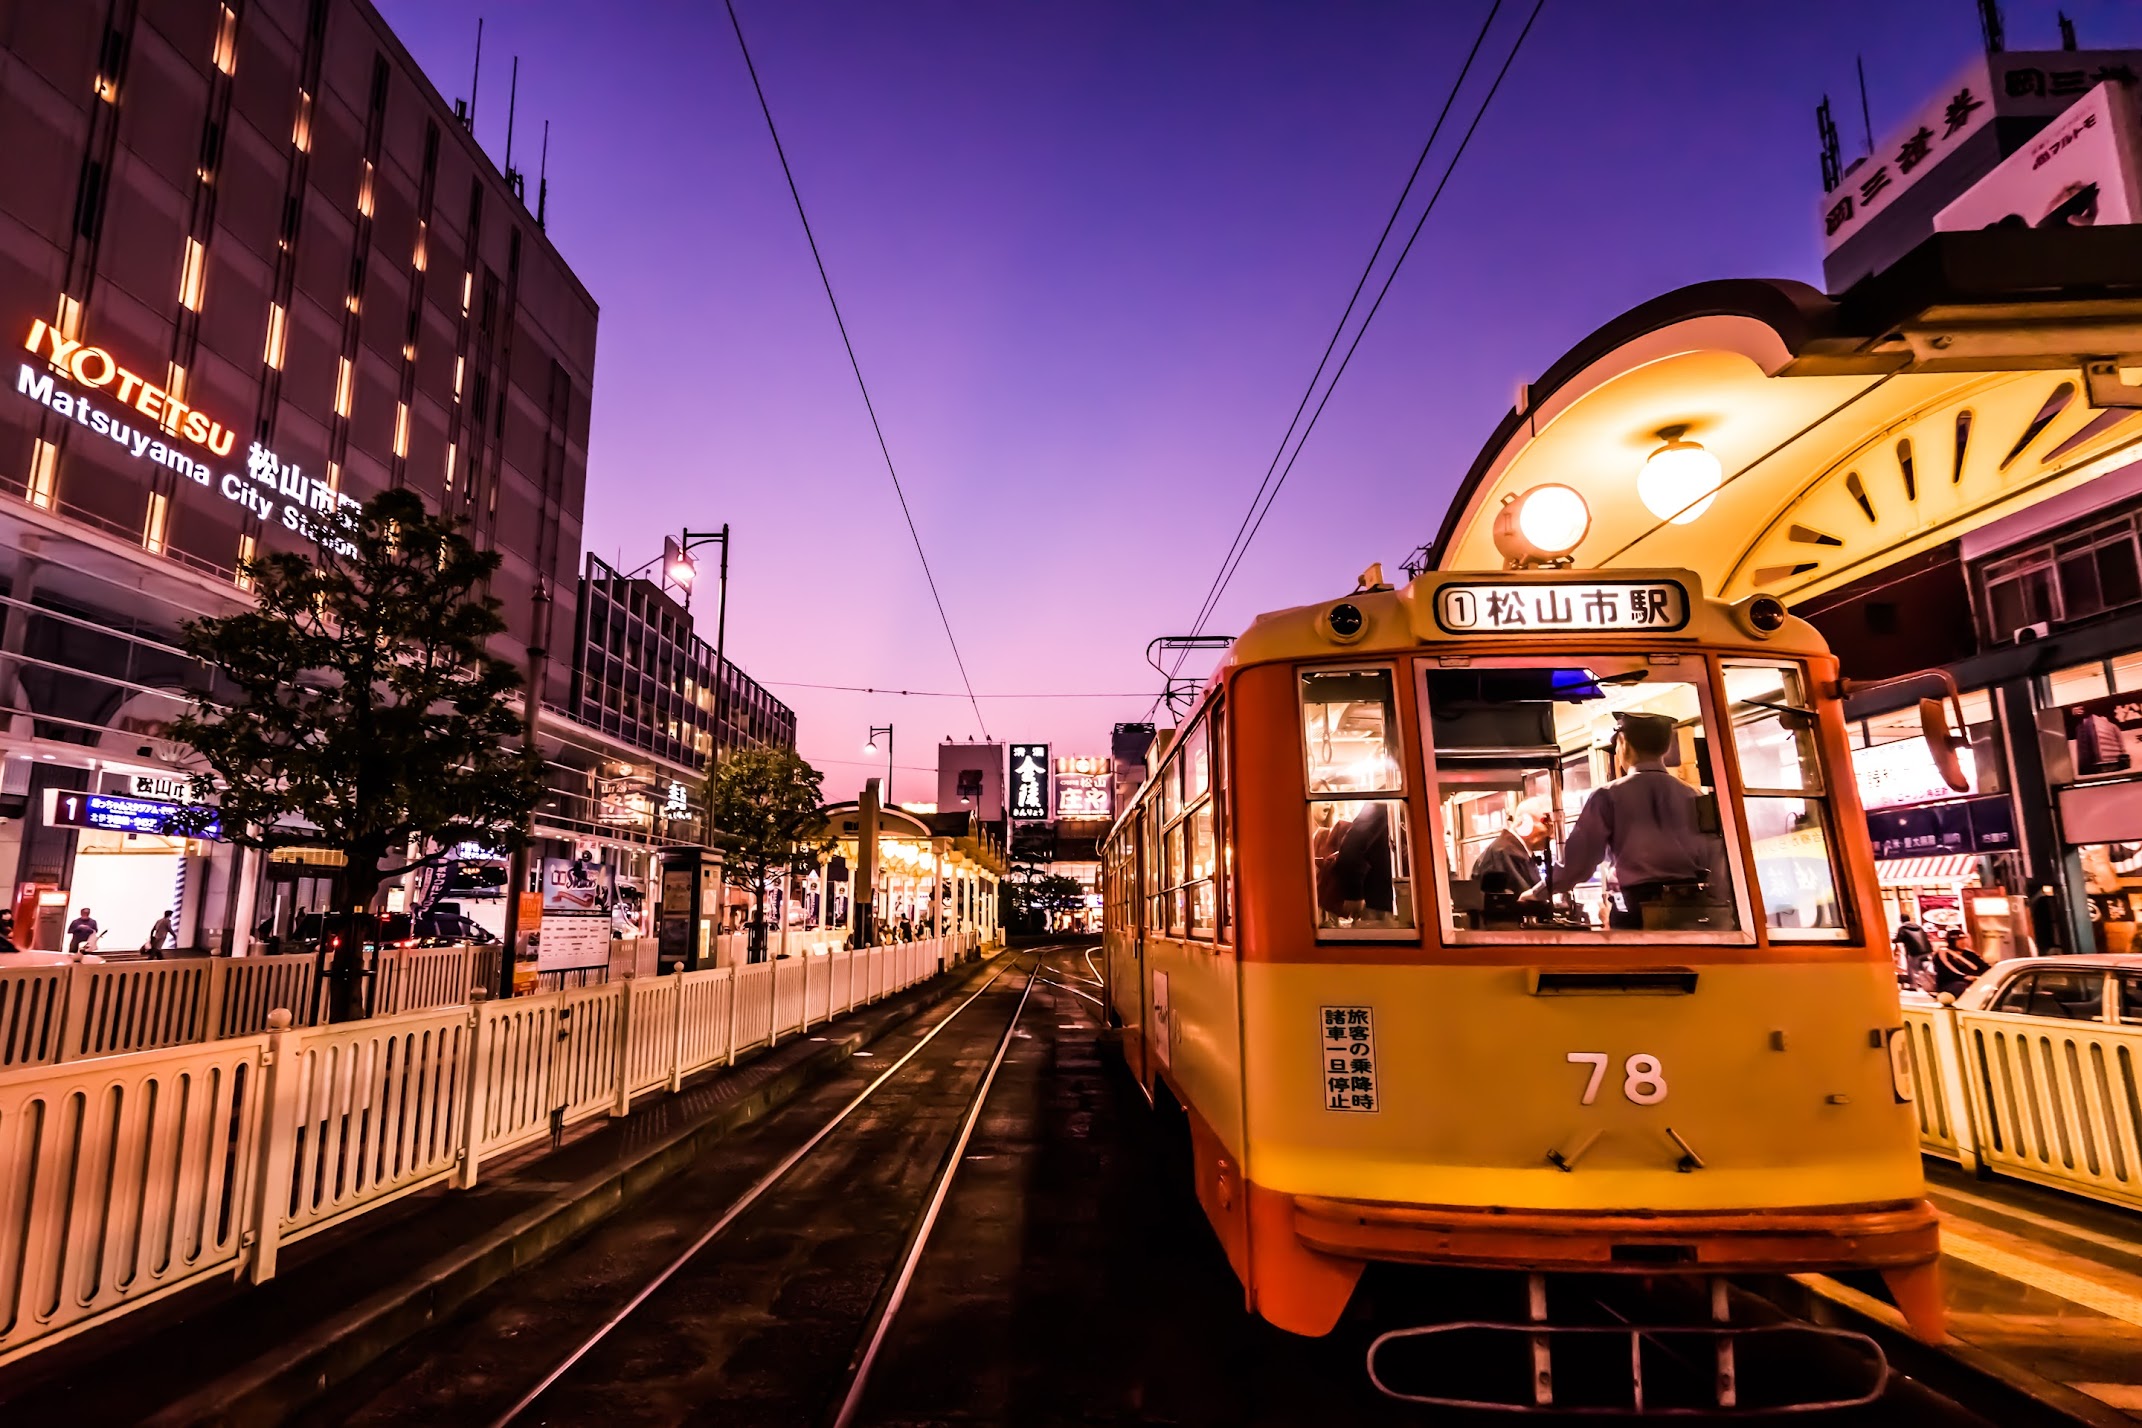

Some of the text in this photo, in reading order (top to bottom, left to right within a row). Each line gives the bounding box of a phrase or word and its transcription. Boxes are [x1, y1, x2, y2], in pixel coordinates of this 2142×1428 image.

[25, 318, 236, 457] IYOTETSU
[17, 363, 211, 487] Matsuyama
[221, 473, 274, 520] City
[1486, 588, 1670, 627] 松山市駅
[66, 797, 77, 821] 1
[1059, 787, 1108, 809] 庄や
[1080, 777, 1107, 788] 松山
[1325, 1009, 1351, 1109] 諸車一旦停止
[1347, 1009, 1374, 1110] 旅客の乗降時
[1567, 1052, 1668, 1106] 78
